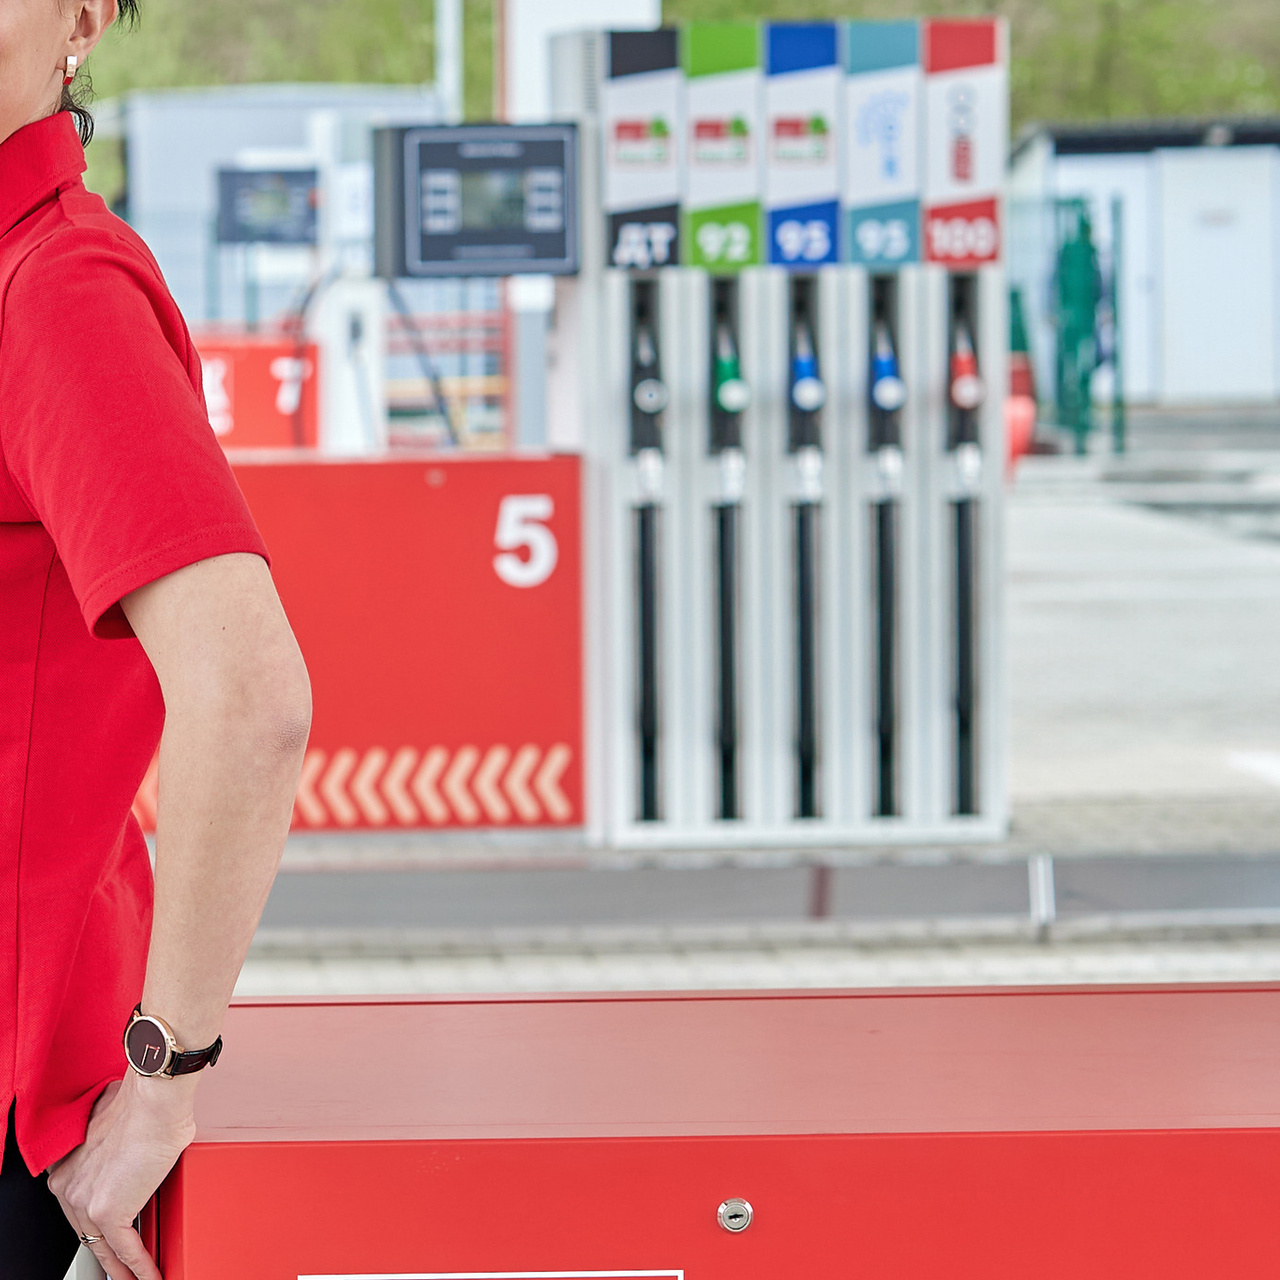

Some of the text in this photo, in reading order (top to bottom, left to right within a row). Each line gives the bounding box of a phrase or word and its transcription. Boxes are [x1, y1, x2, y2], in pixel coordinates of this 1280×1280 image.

[613, 222, 676, 268] ДТ
[697, 221, 751, 261] 92
[776, 220, 830, 261] 95
[927, 218, 997, 258] 100
[270, 357, 313, 415] 7
[494, 494, 558, 588] 5
